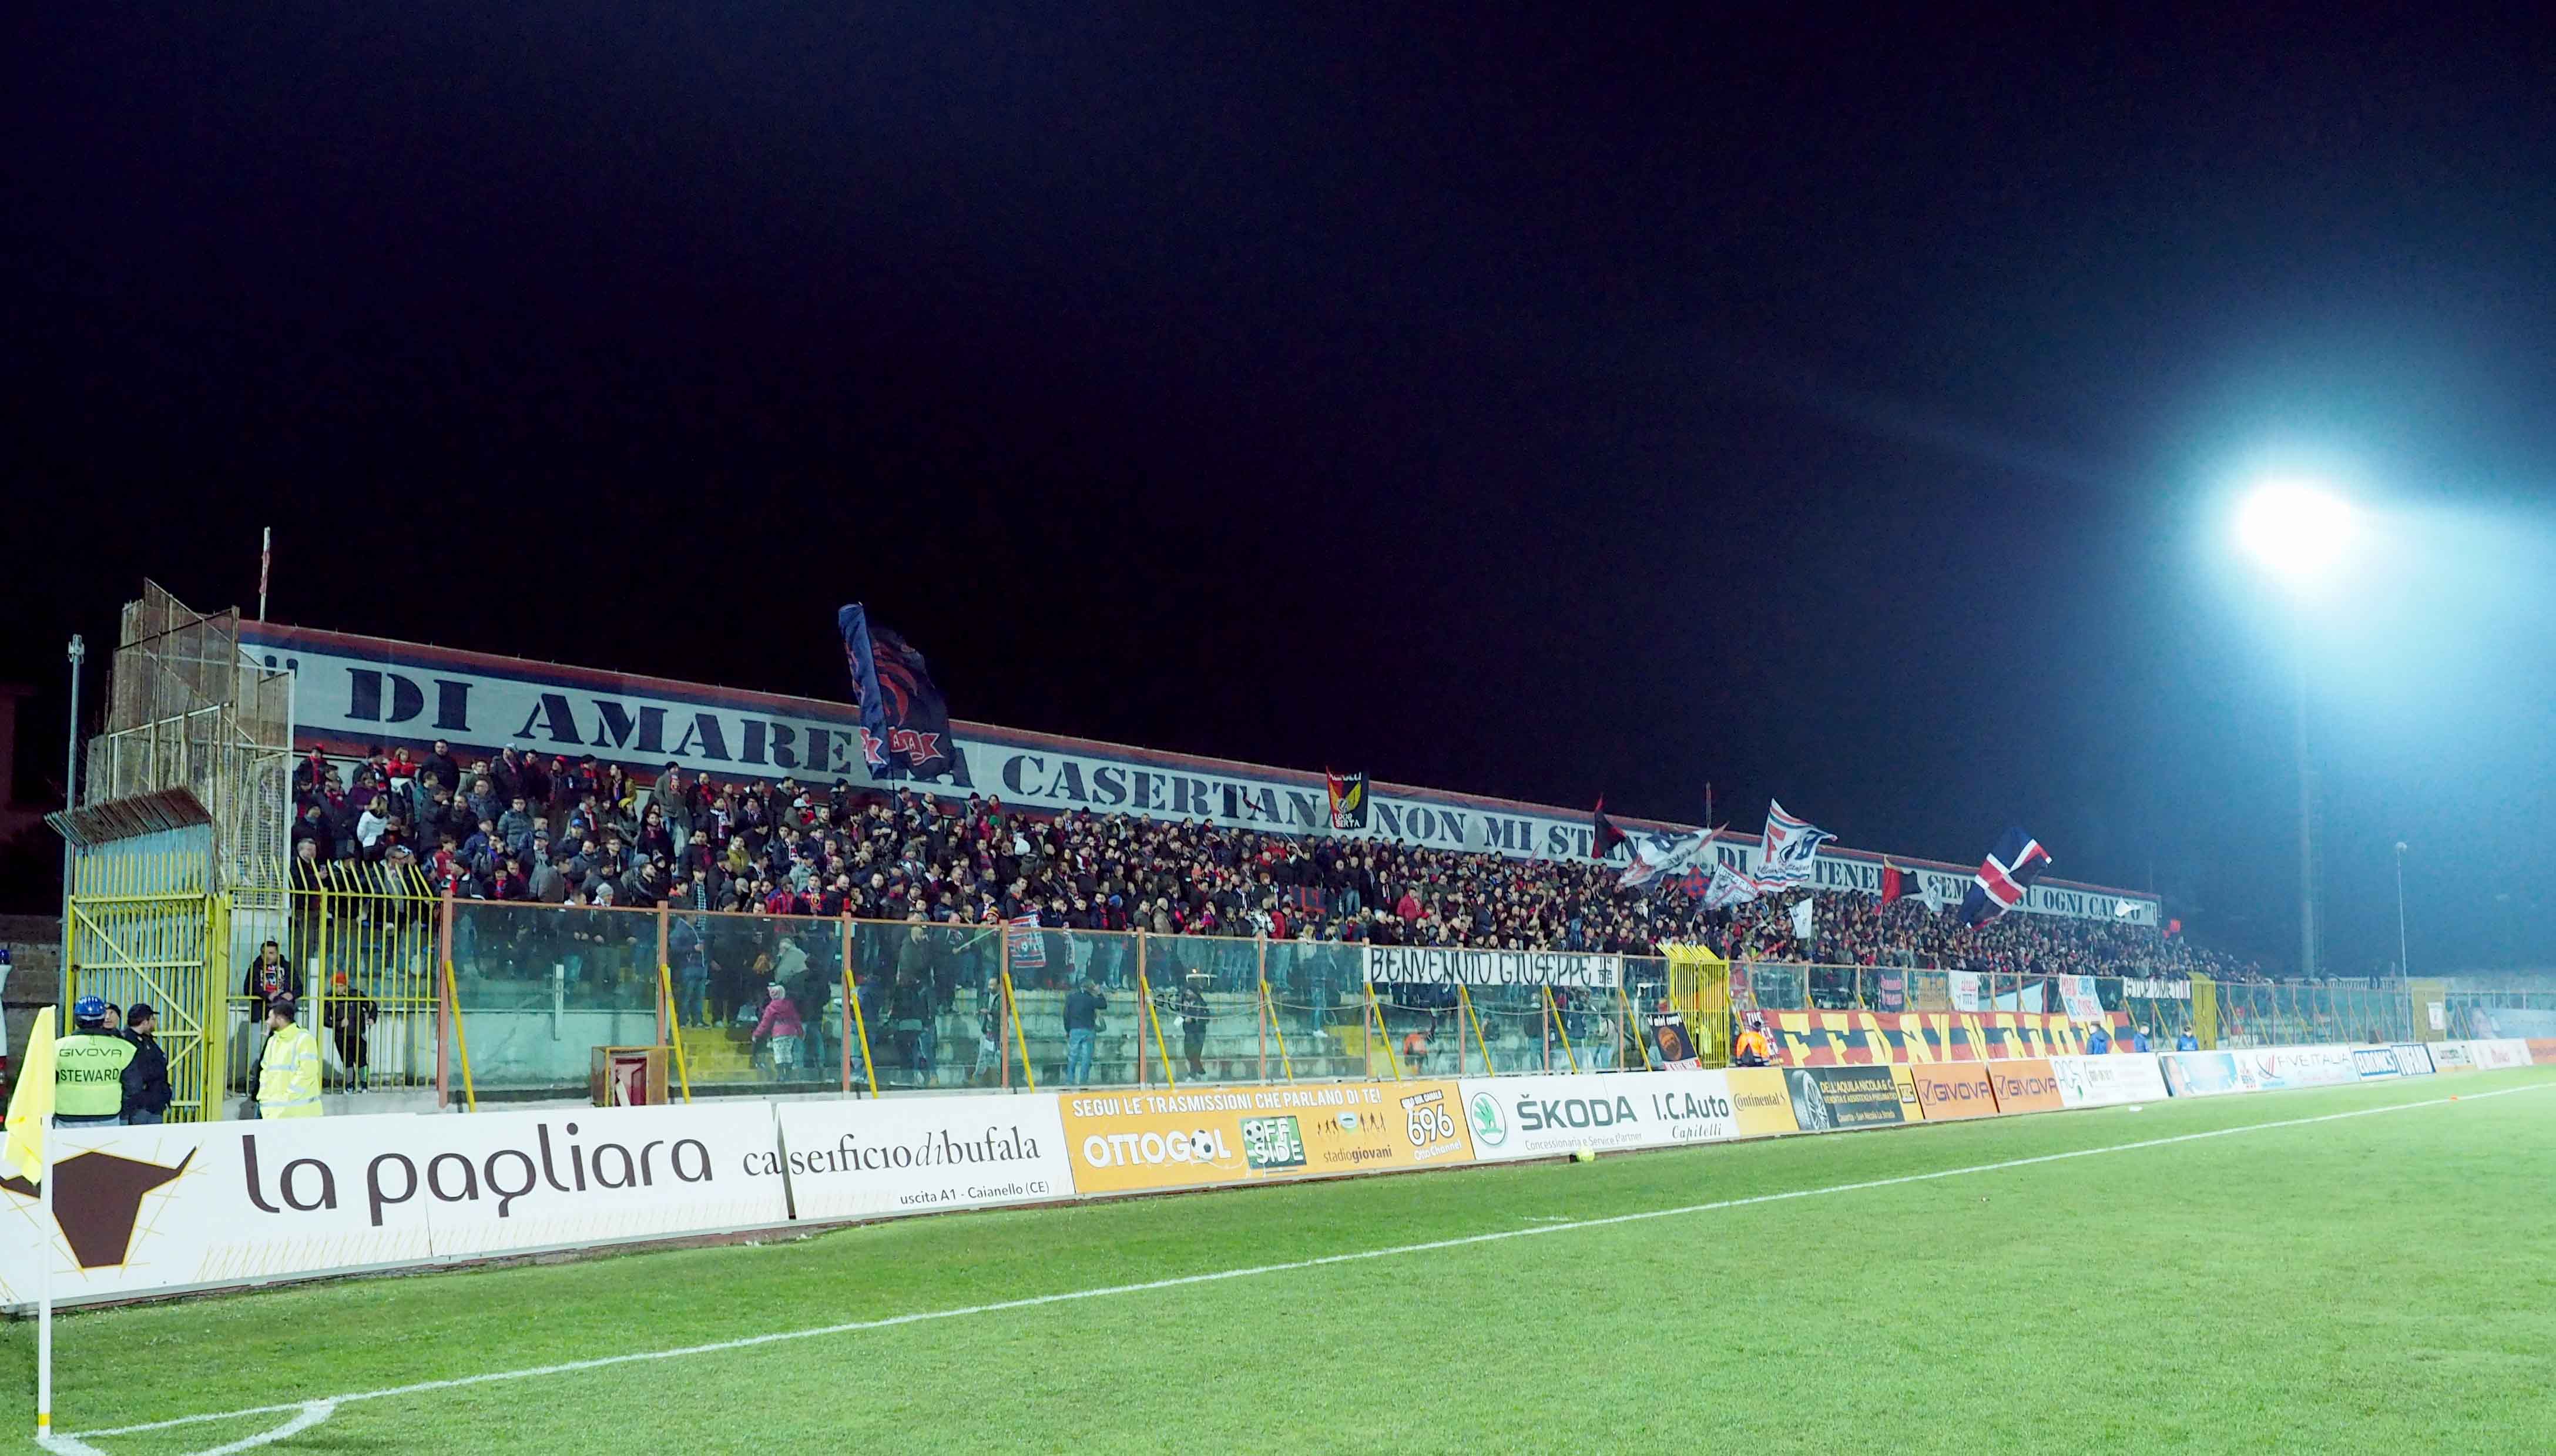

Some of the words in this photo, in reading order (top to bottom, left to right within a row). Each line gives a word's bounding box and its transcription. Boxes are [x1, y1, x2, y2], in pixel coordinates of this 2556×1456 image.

[344, 667, 473, 732] DI
[512, 693, 851, 775] AMARE
[1002, 754, 1332, 829] CASERTAN
[1373, 802, 1466, 844] NON
[1484, 816, 1533, 851] MI
[1716, 846, 1748, 875] DI
[2044, 891, 2084, 912] OGNI
[2089, 896, 2140, 921] CAMO
[1370, 948, 1492, 984] BENVENUTO
[1499, 952, 1591, 985] GIUSEPPE
[59, 1048, 122, 1058] GIVOVA
[60, 1068, 119, 1082] STEWARD
[2007, 1077, 2058, 1096] GIVOVA
[1072, 1096, 1120, 1117] SEGUI
[1123, 1096, 1143, 1115] LE
[1147, 1093, 1253, 1114] TRASMISSIONI
[1255, 1092, 1282, 1109] CHE
[1283, 1090, 1344, 1108] PARLANO
[1346, 1089, 1359, 1105] DI
[1362, 1088, 1381, 1103] TE!
[1734, 1091, 1779, 1112] Continental
[1933, 1081, 1992, 1102] GIVOVA
[1517, 1093, 1638, 1131] ŠKODA
[1407, 1103, 1455, 1146] 696
[1672, 1122, 1722, 1142] Capitelli
[1254, 1140, 1304, 1165] SIDE
[1525, 1138, 1582, 1152] Concessionaria
[1588, 1135, 1615, 1148] Service
[1615, 1132, 1643, 1145] Partner
[241, 1134, 337, 1214] la
[367, 1122, 713, 1227] pagliara
[900, 1190, 938, 1205] uscita
[940, 1189, 956, 1202] A1
[967, 1183, 1023, 1200] Caianello
[1026, 1181, 1051, 1196] (CE)
